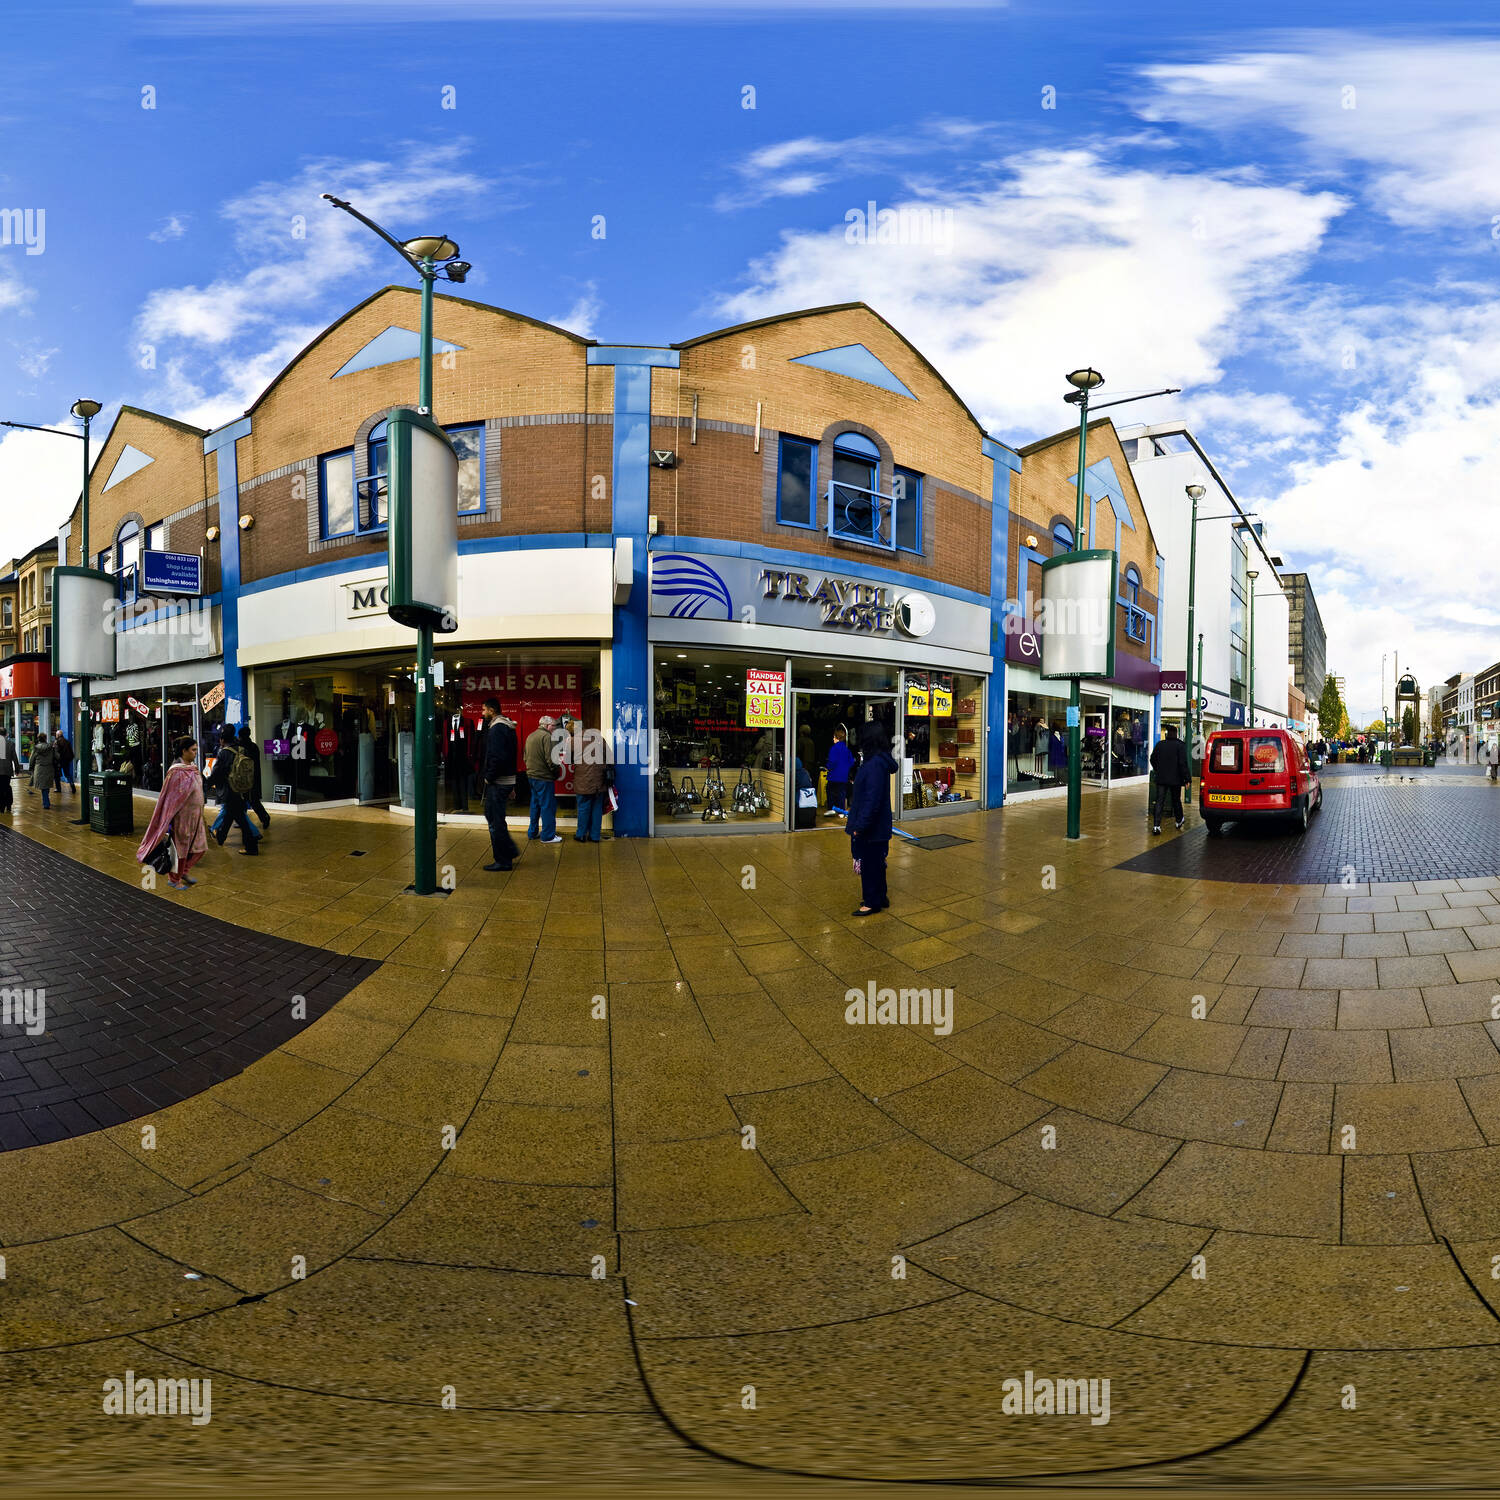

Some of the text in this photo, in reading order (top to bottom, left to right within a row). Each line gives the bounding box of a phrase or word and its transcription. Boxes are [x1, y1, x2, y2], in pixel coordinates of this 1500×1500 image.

[147, 576, 180, 585] Tushingham
[760, 569, 894, 608] TRAVEL
[823, 603, 894, 632] ZONE
[465, 674, 577, 691] SALE SALE
[750, 671, 783, 681] HANDBAG
[749, 682, 782, 695] SALE
[749, 697, 782, 716] £15
[749, 717, 781, 726] HANDBAG
